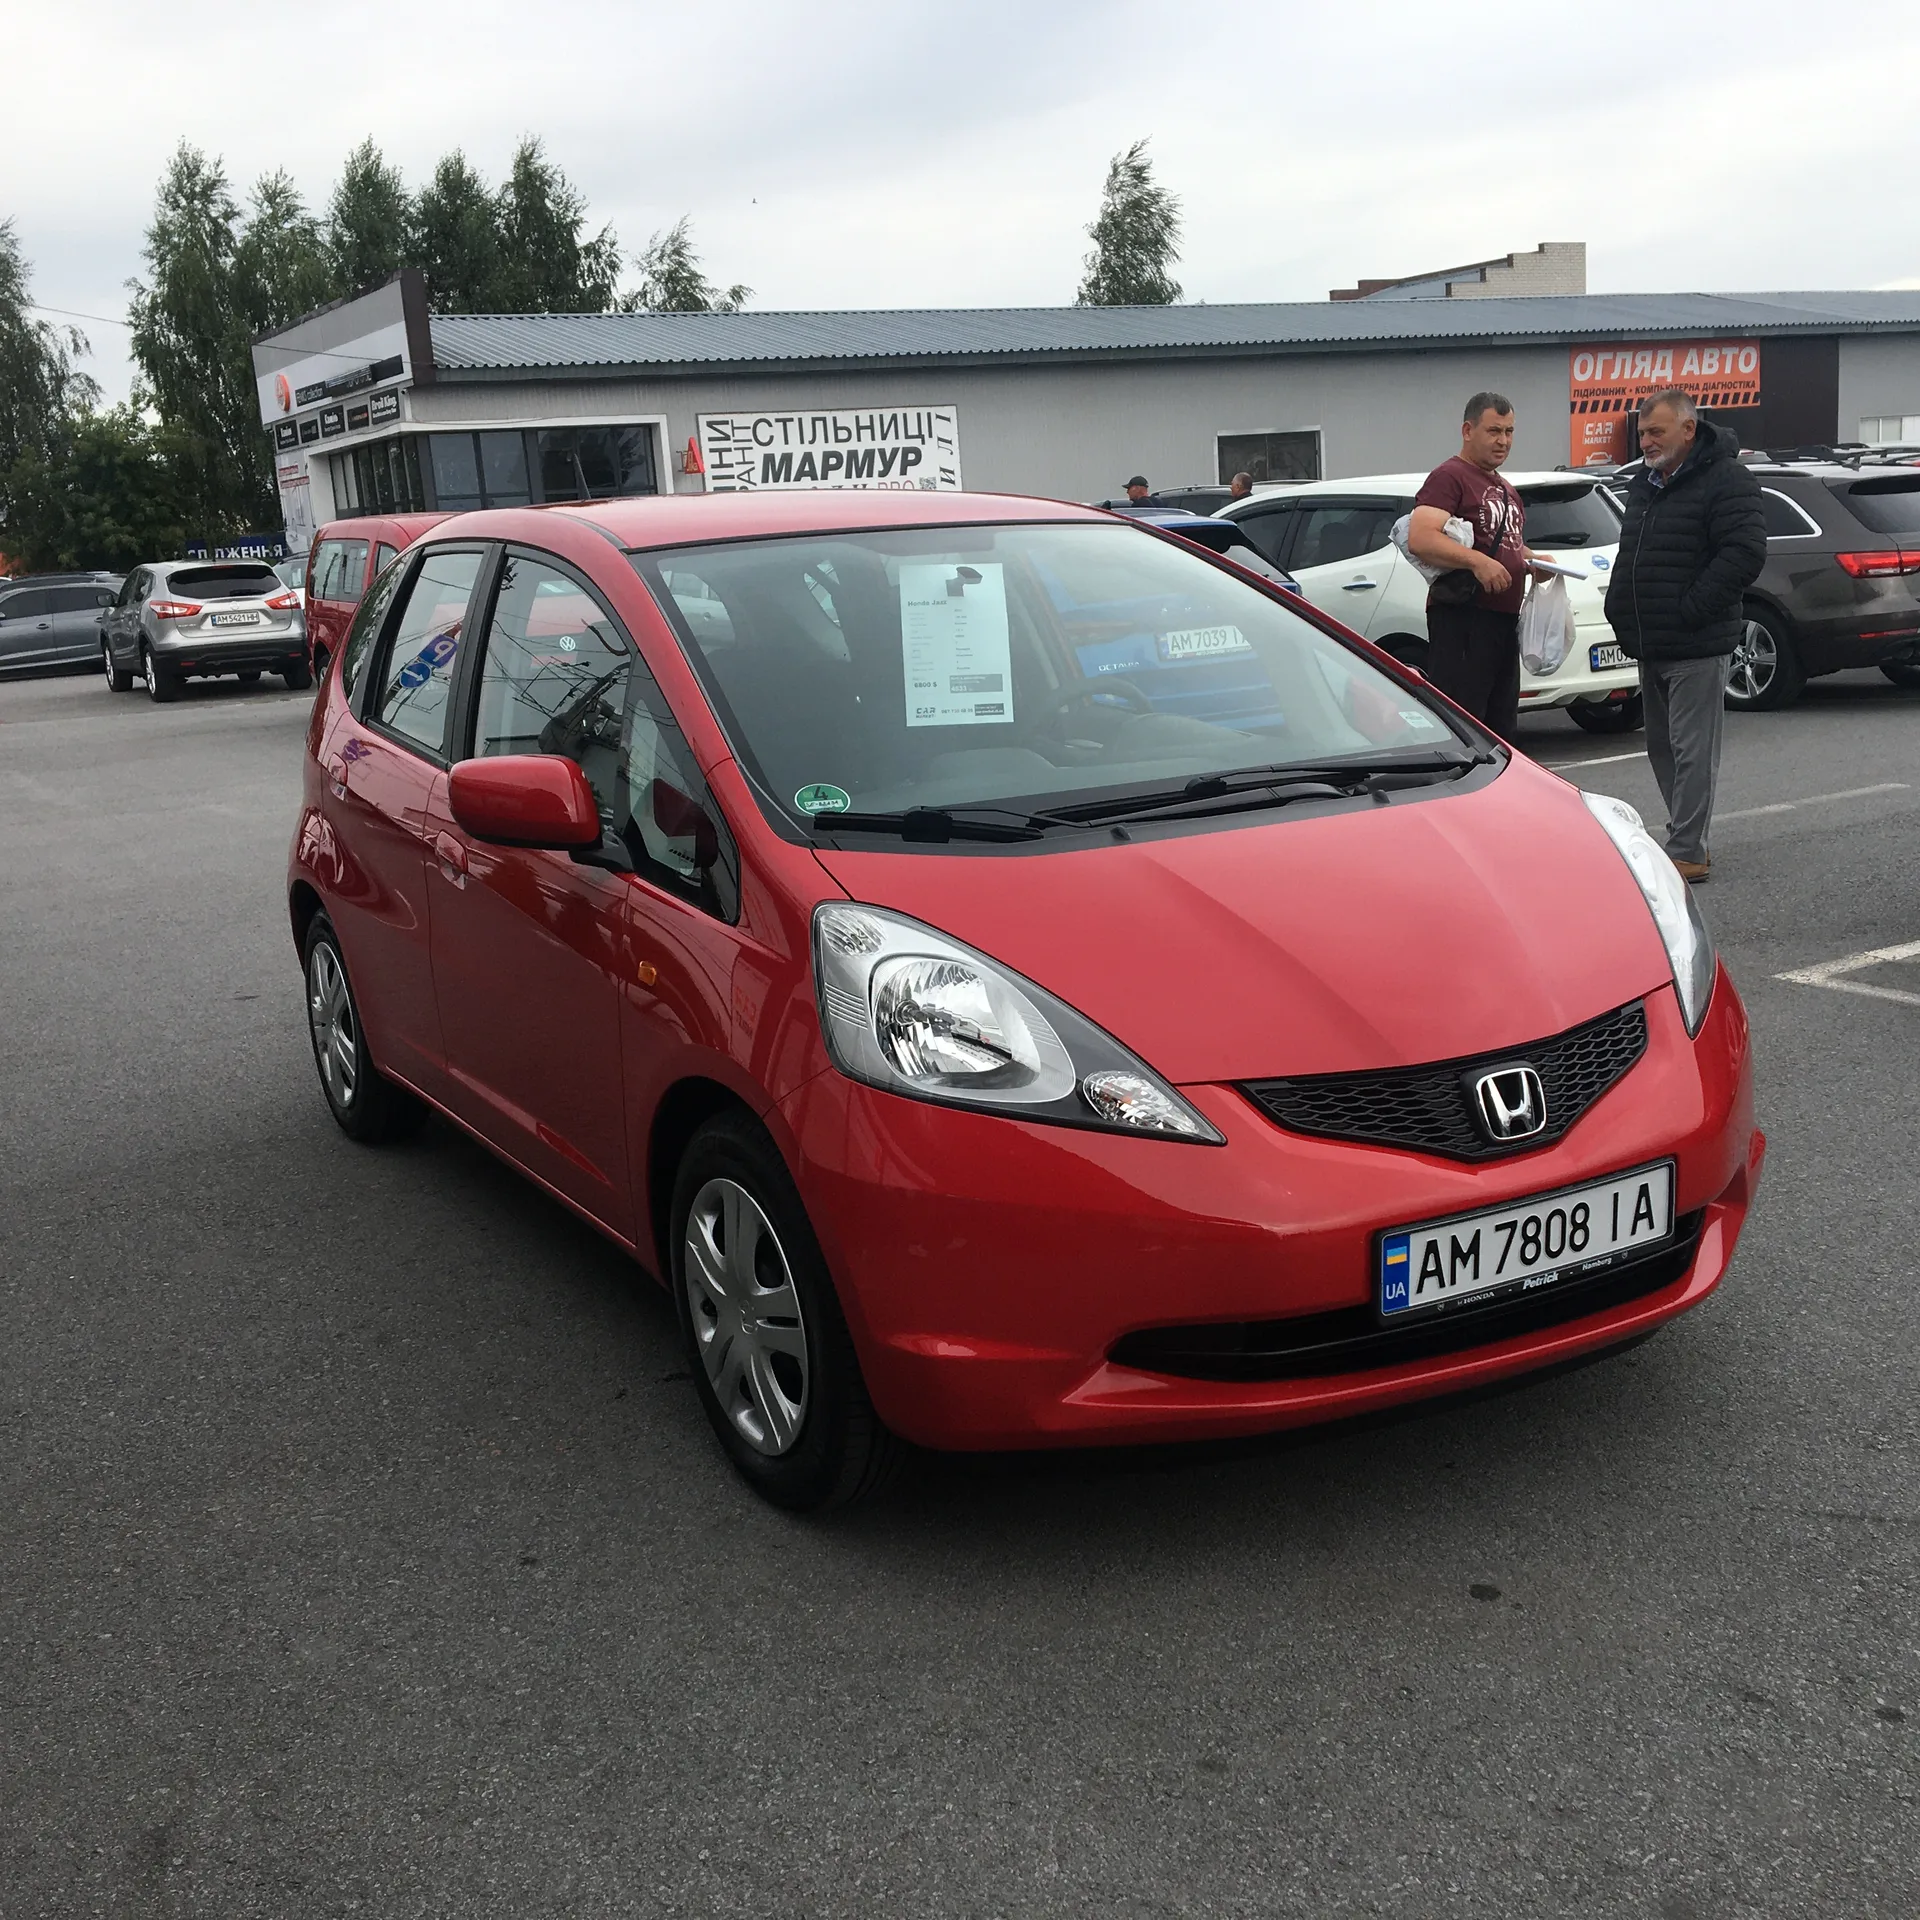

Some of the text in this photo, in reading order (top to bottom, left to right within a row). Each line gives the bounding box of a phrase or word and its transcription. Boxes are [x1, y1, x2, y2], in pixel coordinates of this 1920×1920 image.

[1573, 346, 1758, 383] ОГЛЯД АВТО
[1573, 386, 1627, 399] ПІДЙОМНИК
[1702, 380, 1756, 392] ДІАГНОСТІКА
[752, 412, 933, 446] СТІЛЬНИЦІ
[1585, 421, 1614, 436] CAR
[1584, 436, 1613, 445] MARKET
[761, 446, 922, 484] МАРМУР
[1171, 632, 1192, 652] AM
[1193, 628, 1227, 649] 7039
[814, 786, 828, 800] 4
[1415, 1182, 1655, 1295] AM 7808 IA
[1386, 1284, 1406, 1300] UA
[1463, 1291, 1495, 1305] HONDA
